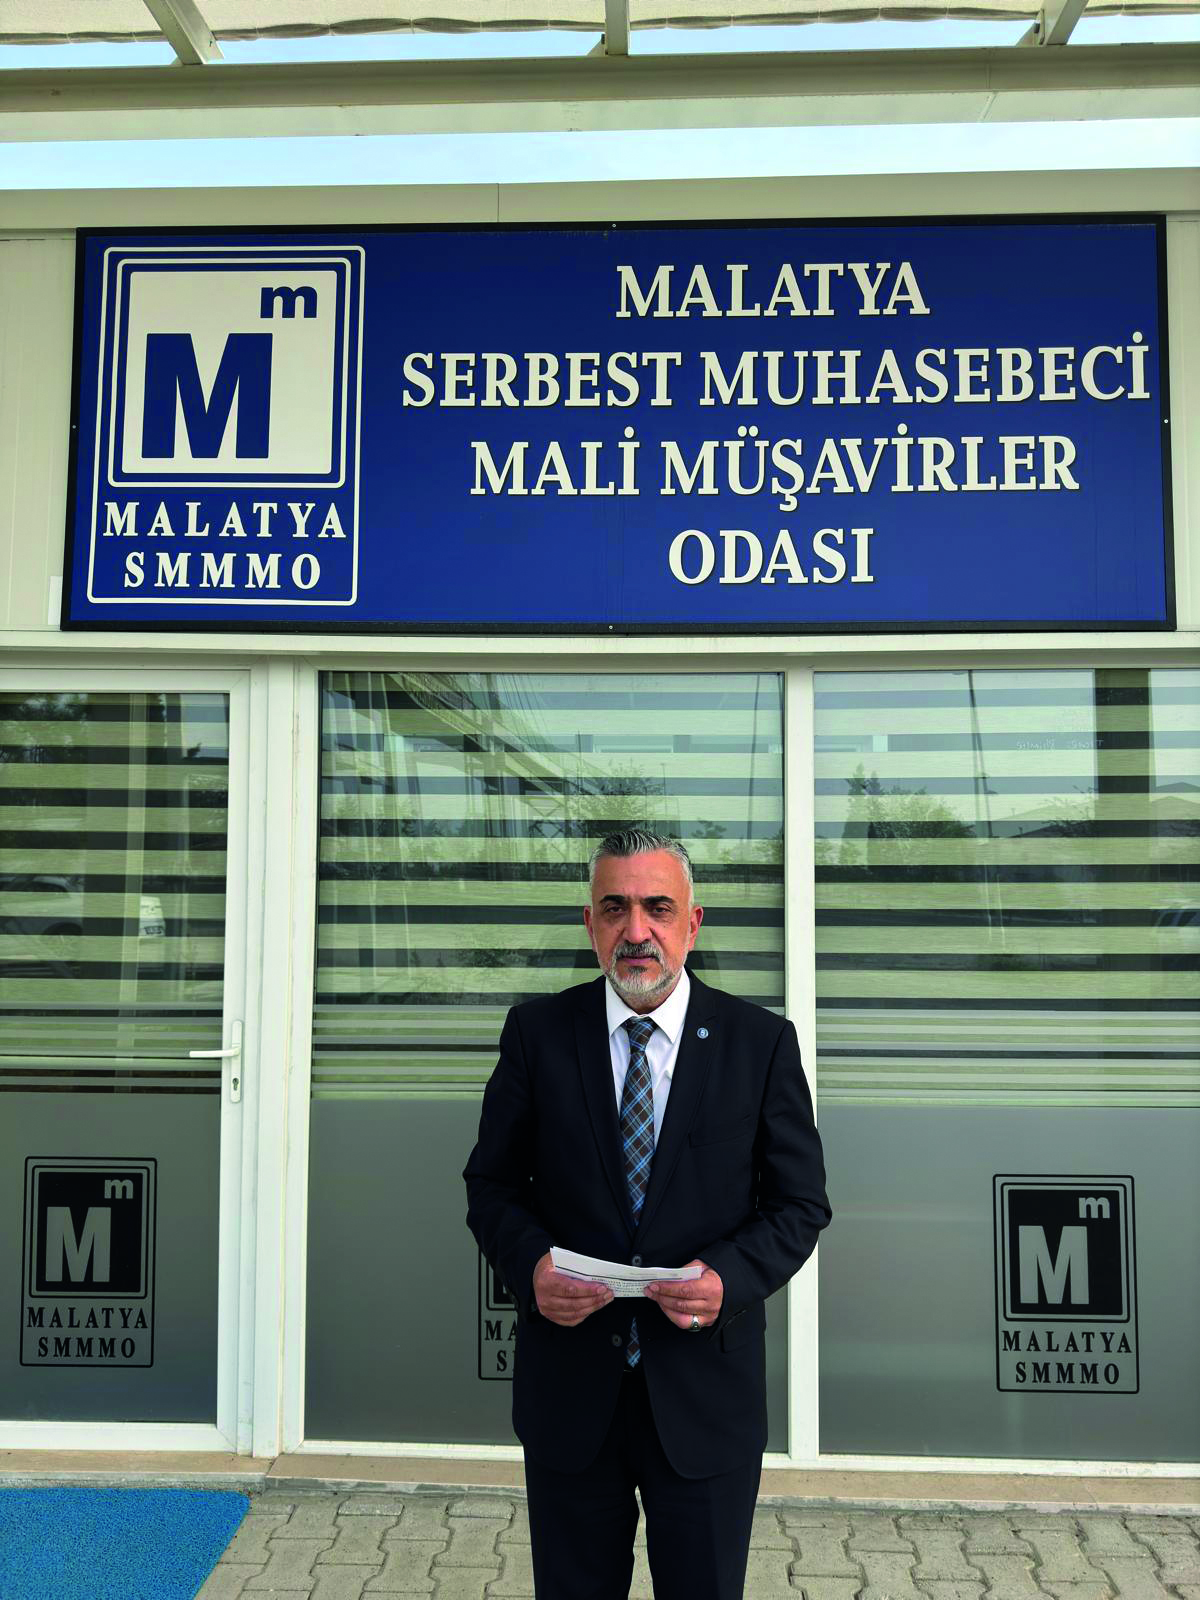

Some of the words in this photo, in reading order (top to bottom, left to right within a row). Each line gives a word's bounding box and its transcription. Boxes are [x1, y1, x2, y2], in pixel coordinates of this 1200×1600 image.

[259, 285, 318, 319] m
[615, 261, 931, 318] MALATYA
[402, 351, 682, 407] SERBEST
[699, 331, 1150, 406] MUHASEBECİ
[141, 332, 274, 459] M
[470, 426, 640, 495] MALİ
[660, 423, 1080, 512] MÜŞAVİRLER
[102, 501, 347, 538] MALATYA
[124, 551, 321, 590] SMMMO
[668, 527, 874, 585] ODASI
[45, 1206, 112, 1283] M
[1018, 1225, 1090, 1305] M
[26, 1306, 149, 1329] MALATYA
[37, 1336, 136, 1359] SMMMO
[1001, 1330, 1132, 1354] MALATYA
[1015, 1361, 1120, 1385] SMMMO
